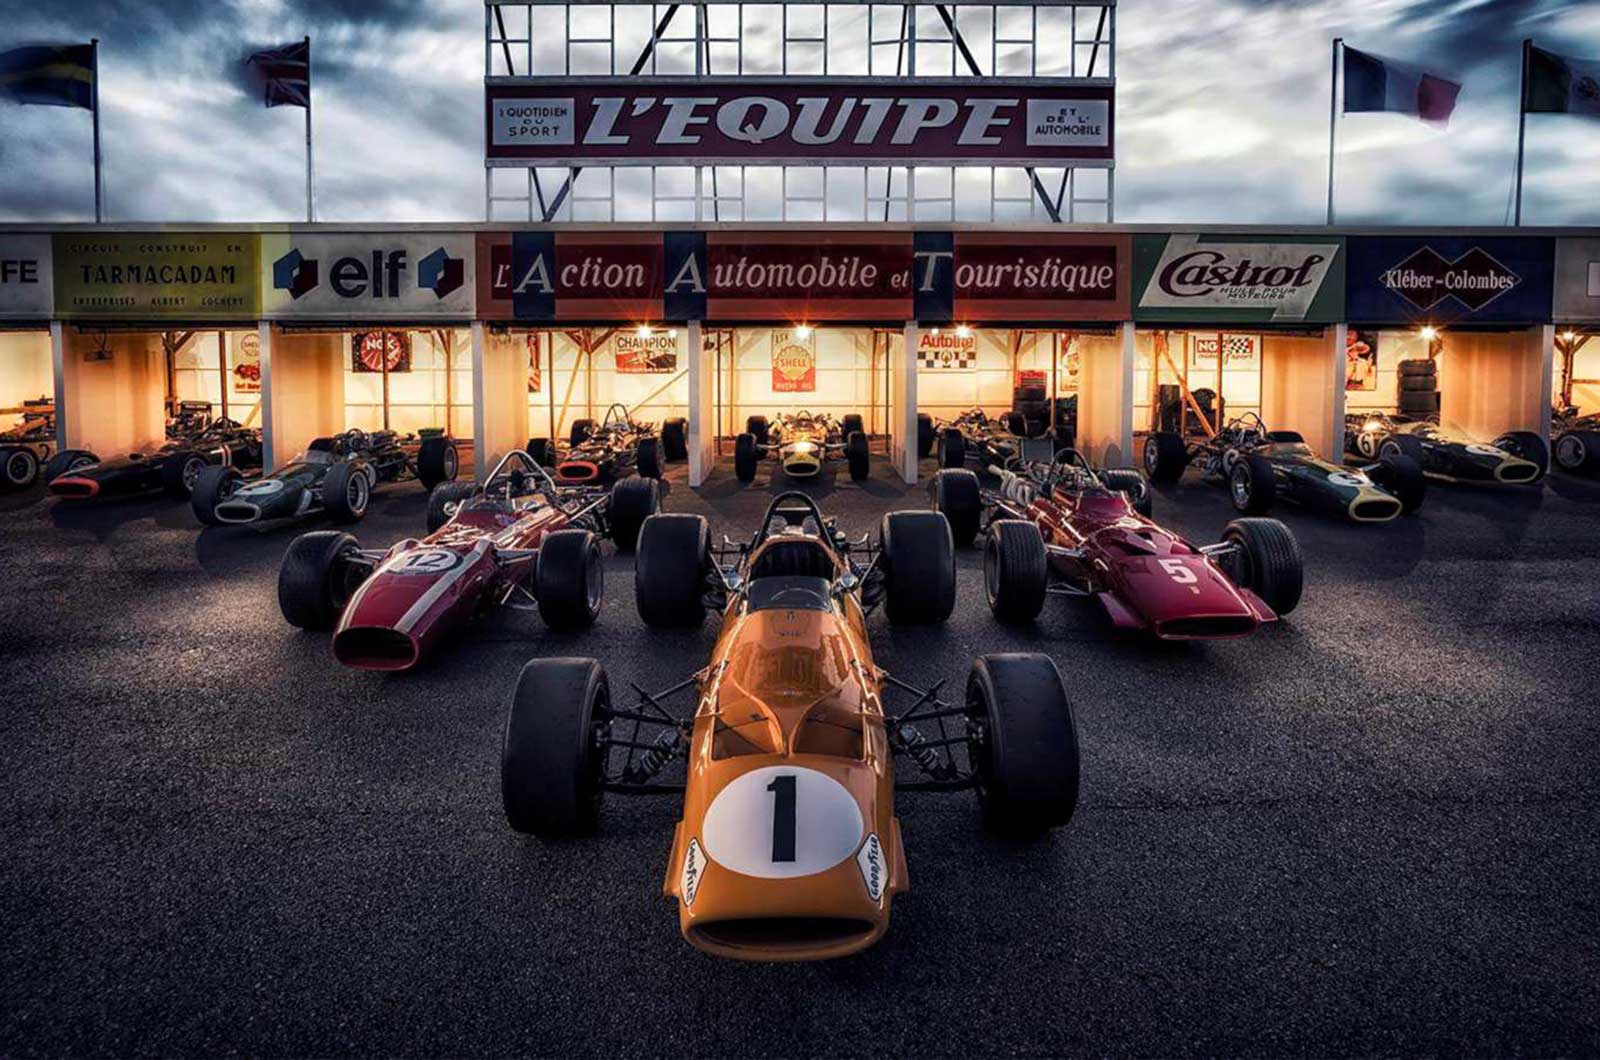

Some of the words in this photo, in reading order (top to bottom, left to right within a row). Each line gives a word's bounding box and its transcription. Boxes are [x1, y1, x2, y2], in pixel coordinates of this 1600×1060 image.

[506, 106, 568, 118] QUOTIDIEN
[582, 96, 1019, 145] L'EQUIPE
[1046, 115, 1065, 123] DE
[1060, 108, 1077, 116] ET
[509, 126, 560, 137] SPORT
[1035, 124, 1102, 136] AUTOMOBILE
[69, 244, 119, 253] CIRCUIT
[139, 244, 208, 253] CONSTRUIT
[226, 244, 242, 253] EN
[80, 265, 236, 284] TARMACADAM
[329, 250, 407, 298] elf
[890, 270, 908, 288] et
[1158, 250, 1325, 297] Castrol
[1362, 433, 1370, 452] 6
[406, 552, 449, 568] 12
[1157, 559, 1199, 584] 5
[766, 775, 797, 863] 1
